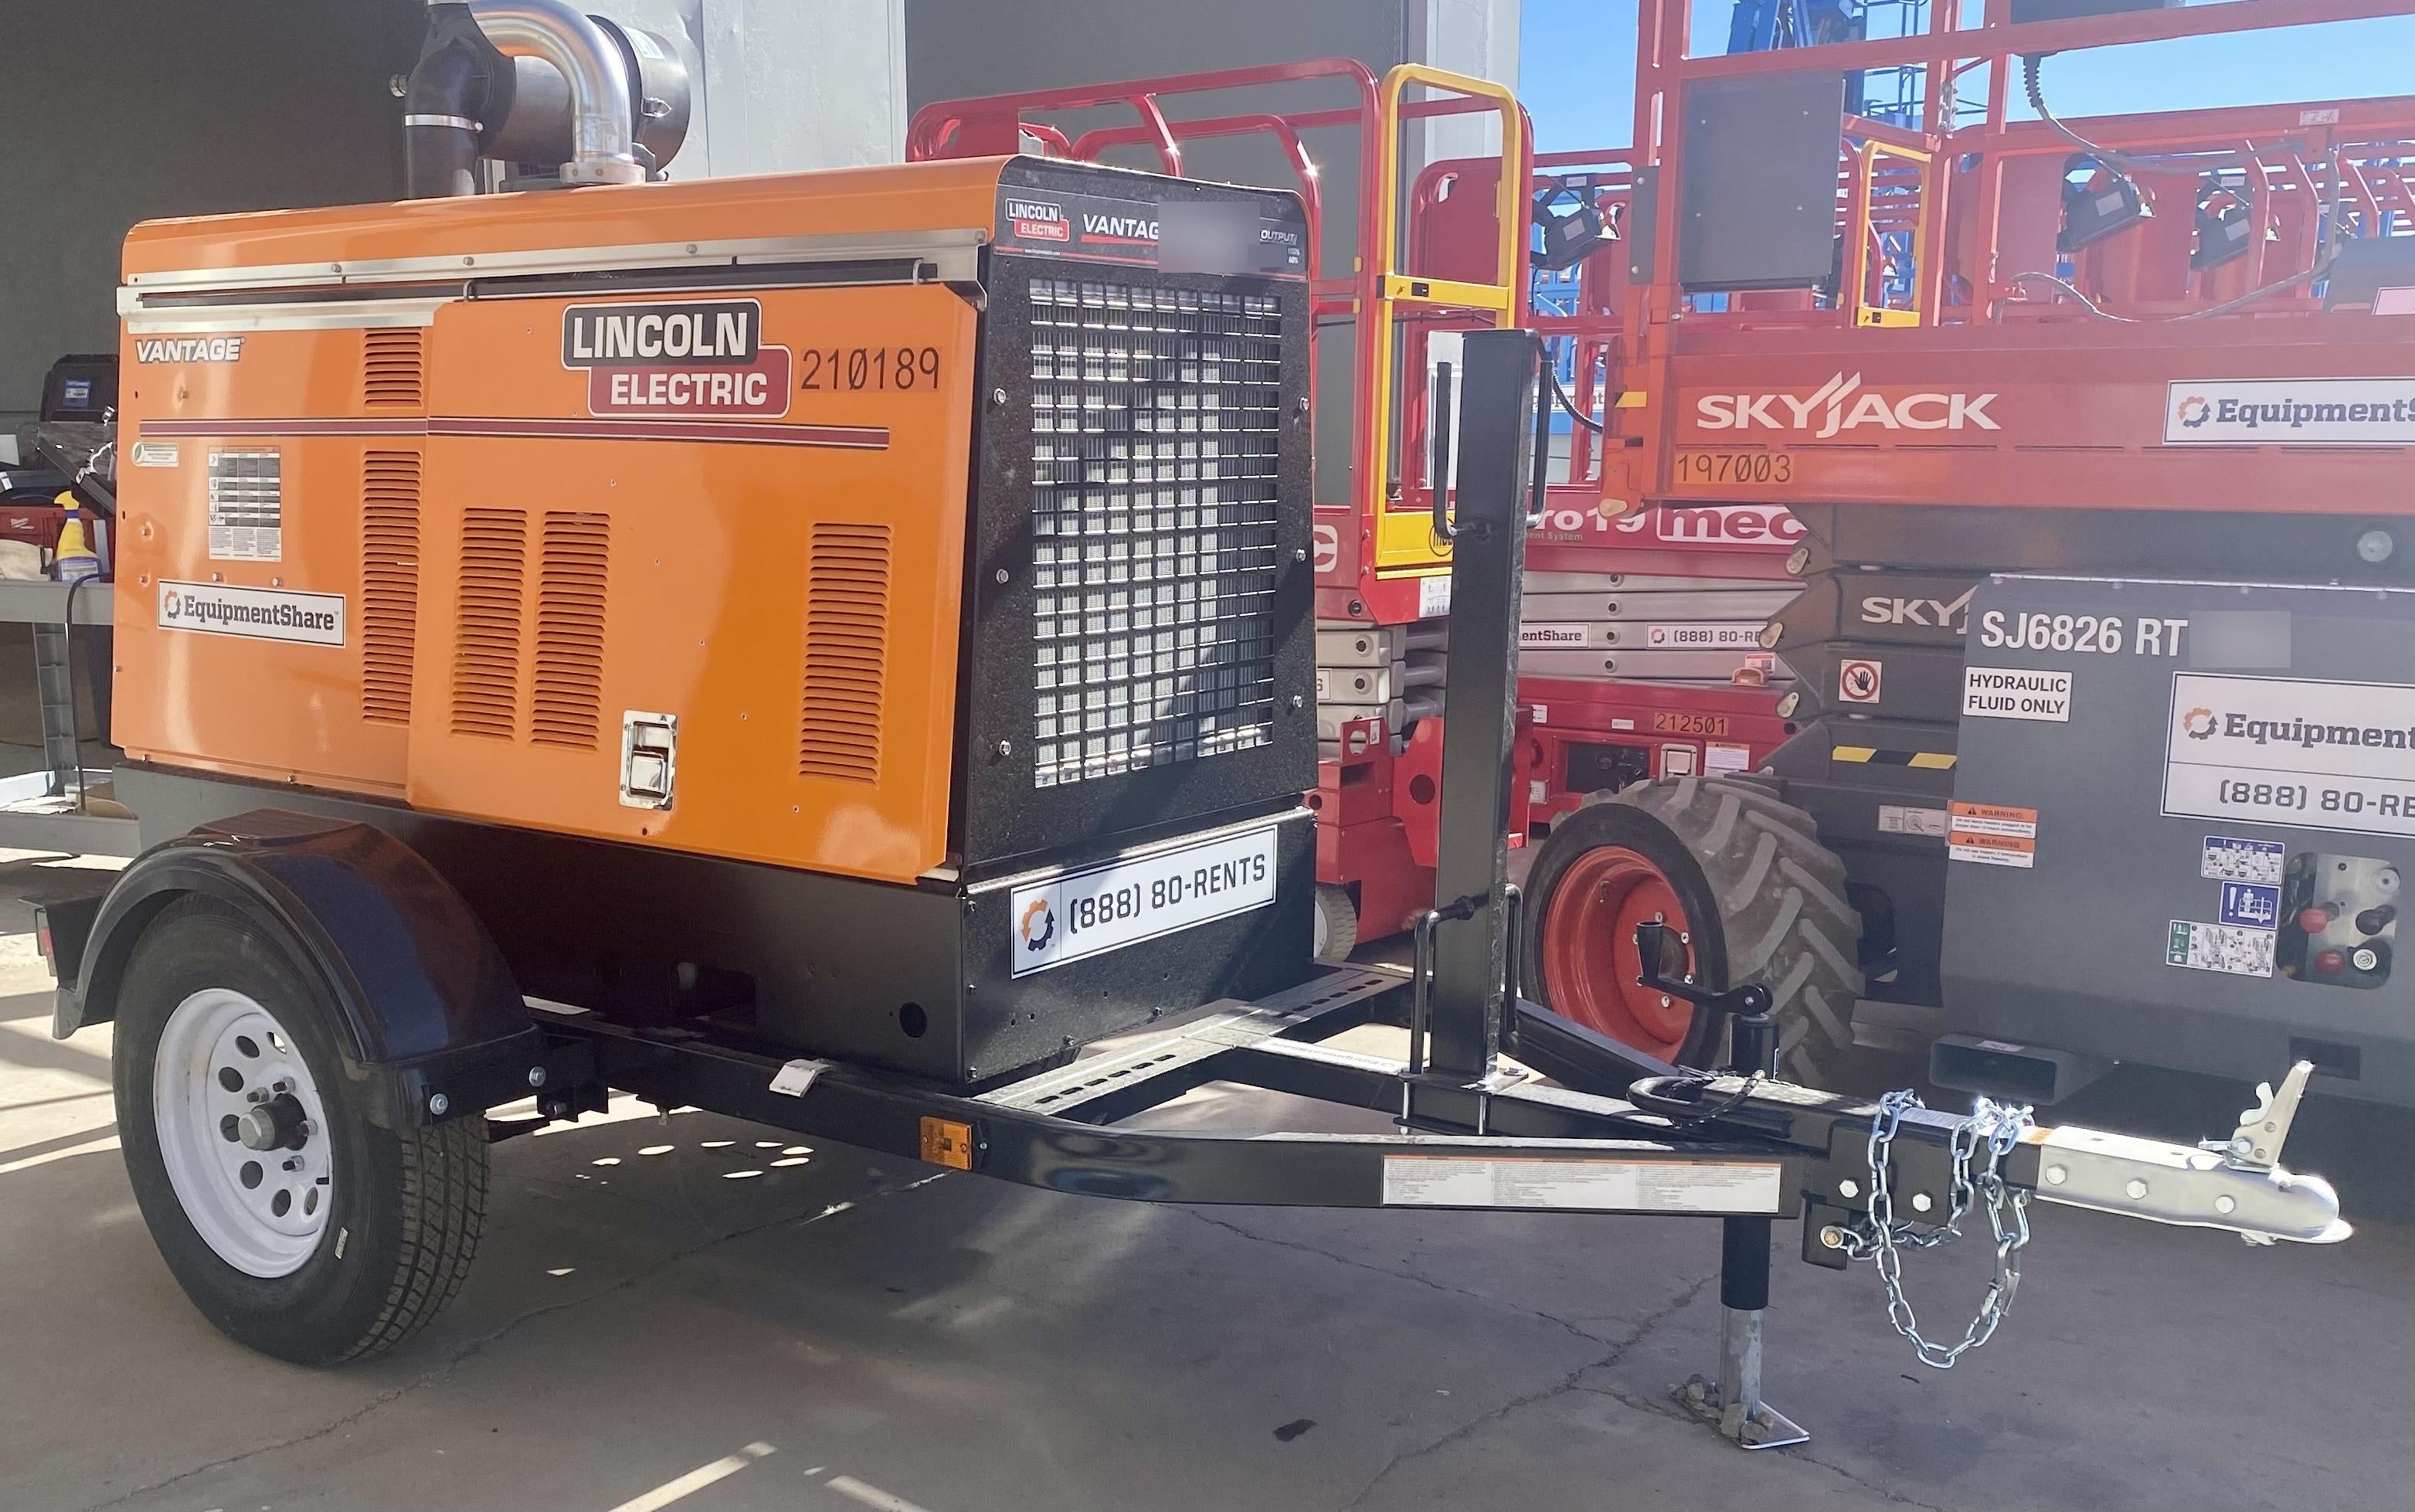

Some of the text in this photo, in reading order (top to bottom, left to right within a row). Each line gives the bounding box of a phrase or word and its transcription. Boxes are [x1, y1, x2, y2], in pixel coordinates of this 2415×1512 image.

[1008, 202, 1058, 222] LINCOLN
[1021, 223, 1064, 237] ELECTRIC
[573, 312, 748, 358] LINCOLN
[136, 338, 243, 363] VANTAGE
[801, 347, 940, 390] 210189
[611, 372, 767, 406] ELECTRIC
[1696, 370, 2002, 439] SKYJACK
[1677, 454, 1792, 483] 197003
[1660, 507, 1809, 541] mec
[184, 594, 335, 631] EquipmentShare
[1520, 630, 1582, 641] entShare
[1673, 630, 1714, 644] (888)
[1980, 610, 2189, 656] SJ6826 RT
[1969, 672, 2068, 693] HYDRAULIC
[1968, 695, 2065, 715] FLUID ONLY
[1656, 712, 1727, 735] 212501
[2219, 779, 2308, 810] (888)
[1981, 808, 2023, 820] WARNING
[1979, 838, 2021, 849] WARNING
[1069, 853, 1266, 935] (888) 80-RENTS
